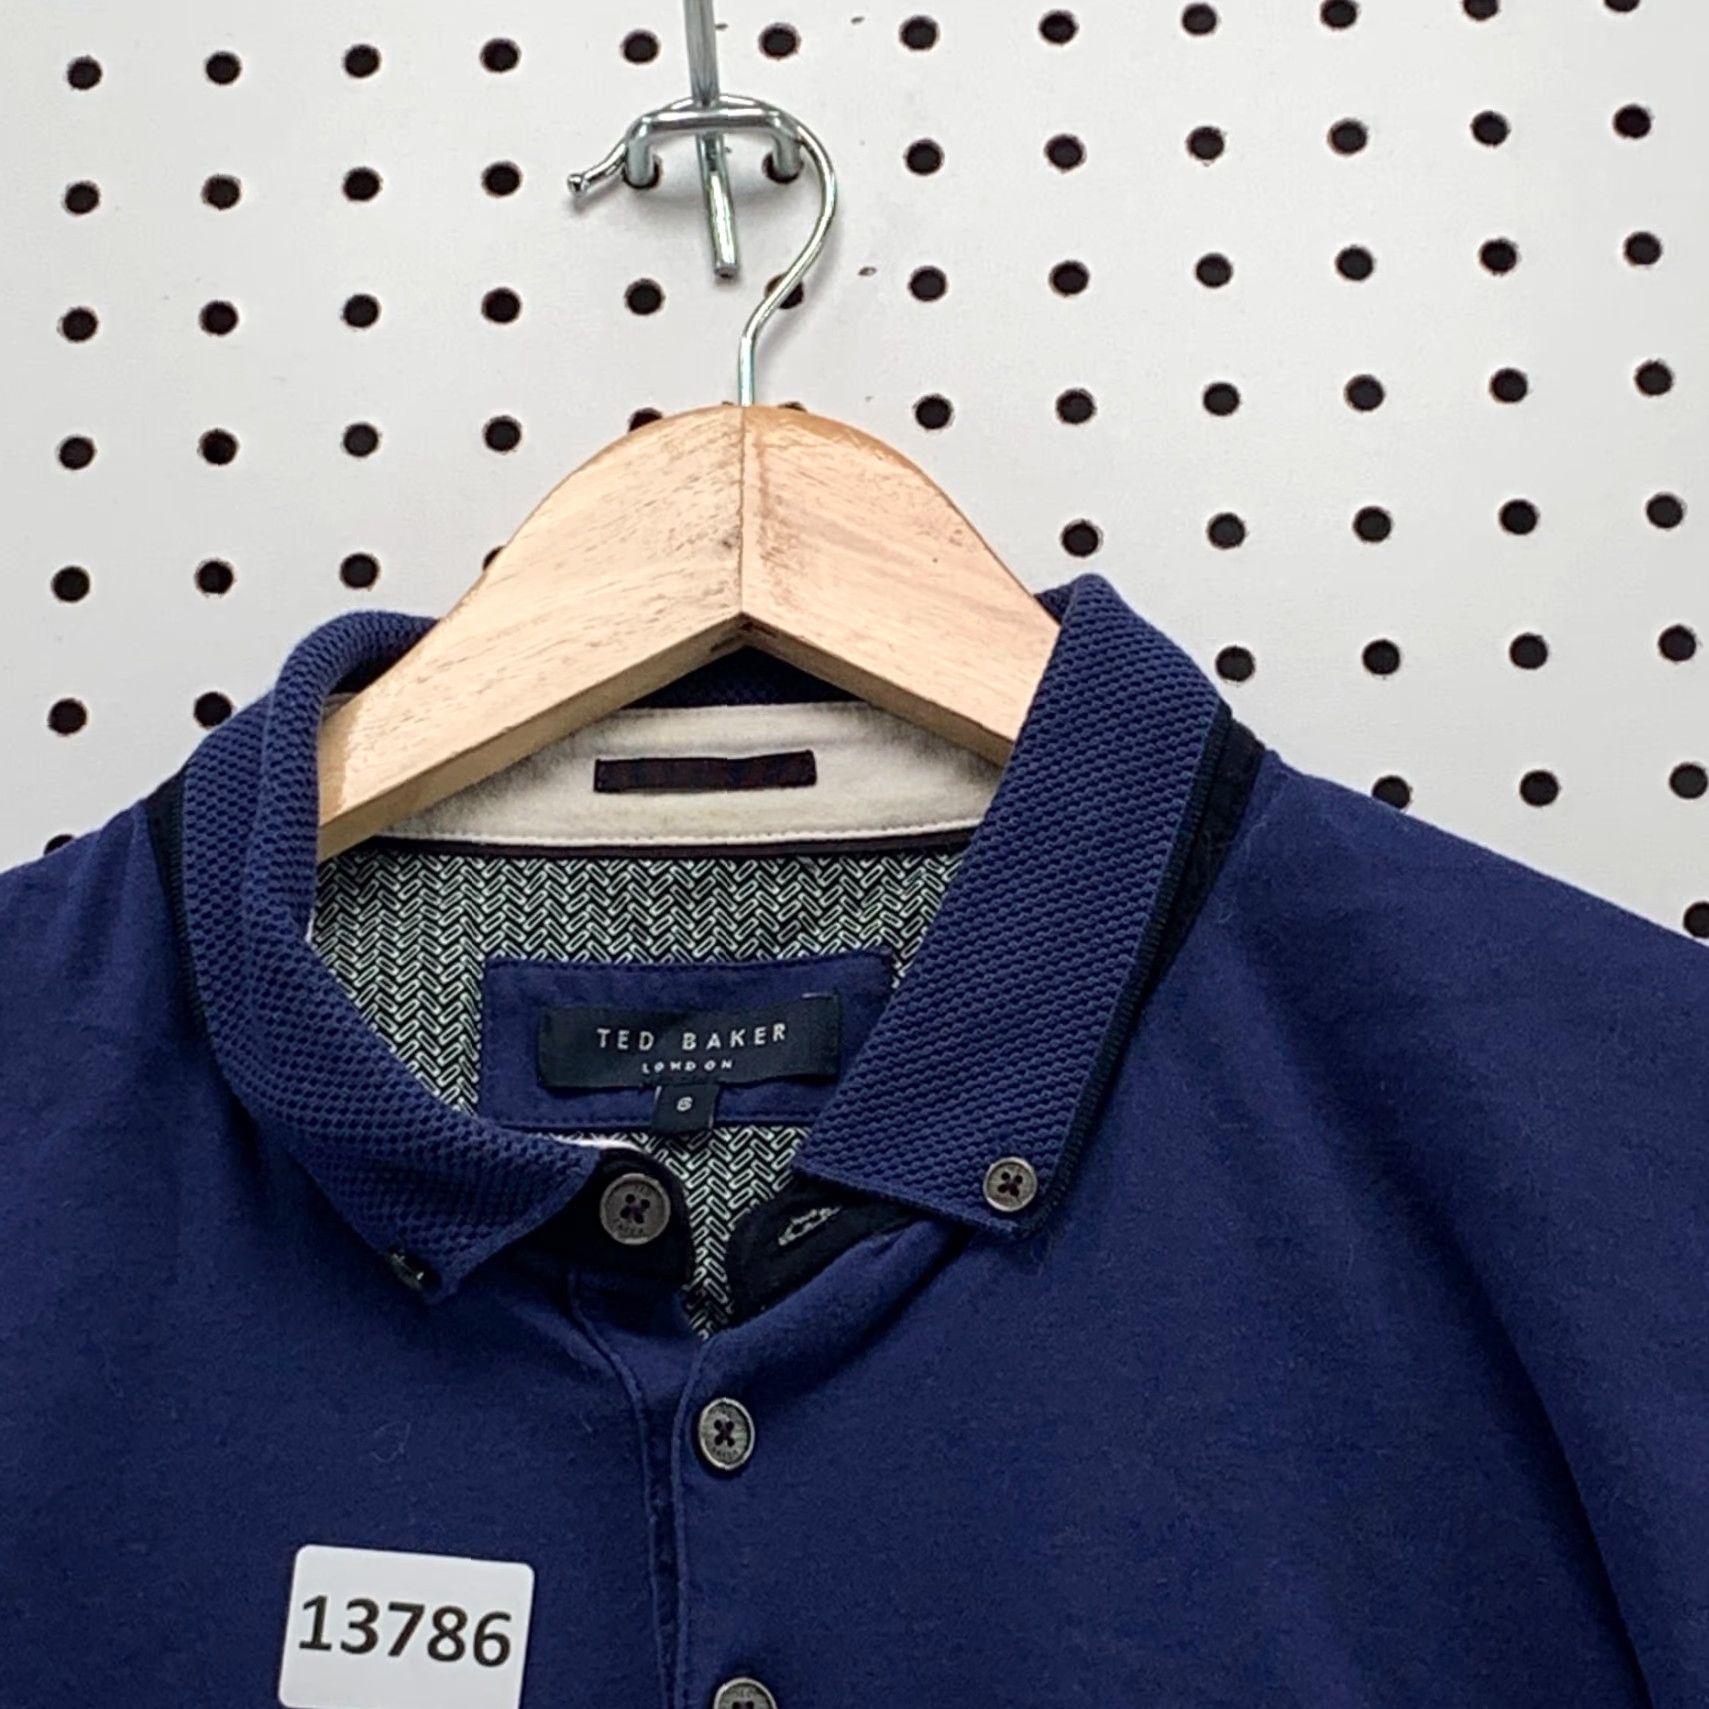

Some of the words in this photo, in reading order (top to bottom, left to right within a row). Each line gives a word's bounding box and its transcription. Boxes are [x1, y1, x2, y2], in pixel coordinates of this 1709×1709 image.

[597, 1028, 654, 1051] TED
[682, 1023, 787, 1051] BAKER
[642, 1060, 733, 1074] LONDON
[676, 1096, 693, 1112] 6
[298, 1595, 512, 1668] 13786
